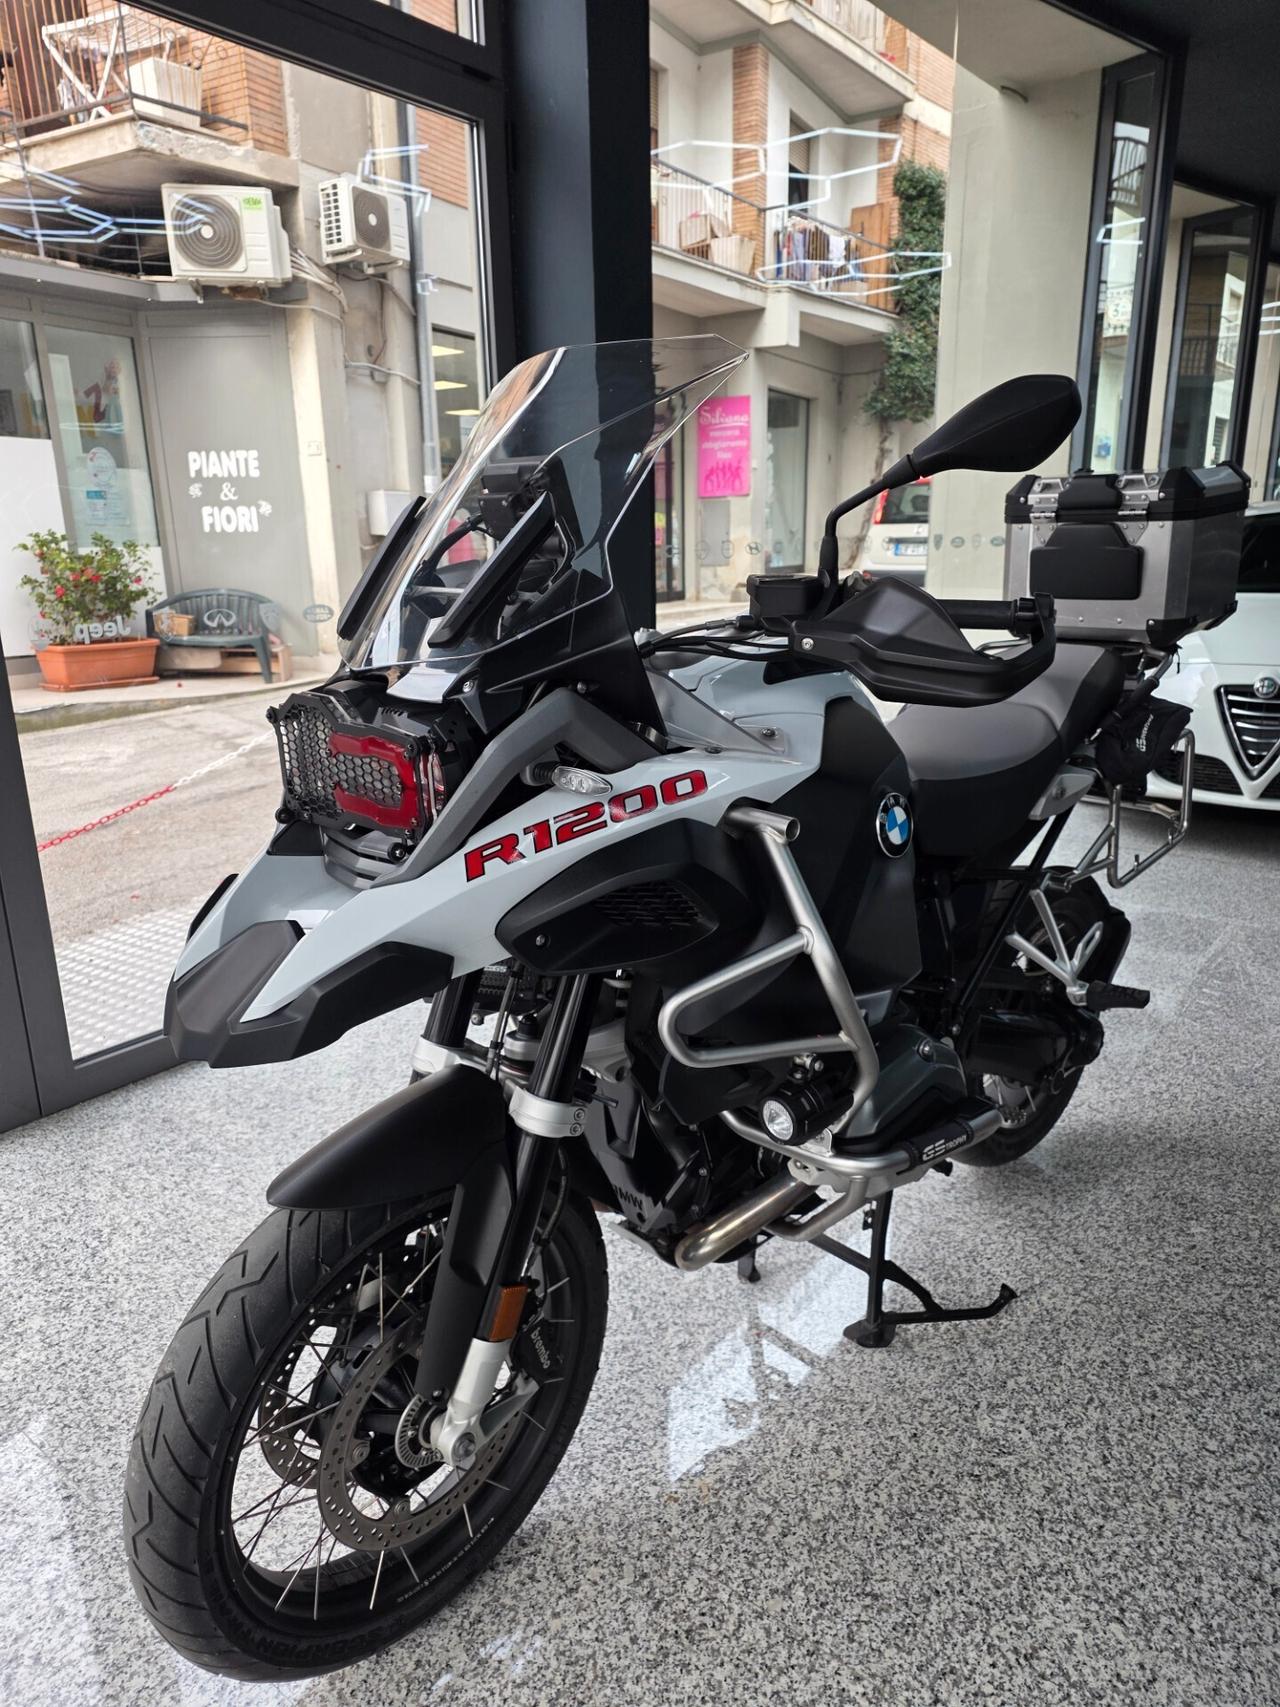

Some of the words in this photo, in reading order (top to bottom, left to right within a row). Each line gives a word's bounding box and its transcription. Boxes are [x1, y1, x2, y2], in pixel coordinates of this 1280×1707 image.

[187, 450, 261, 479] PIANTE
[219, 482, 239, 501] &
[201, 505, 259, 534] FIORI
[464, 769, 709, 882] R1200
[922, 1139, 946, 1162] GS
[530, 1327, 551, 1369] brembo
